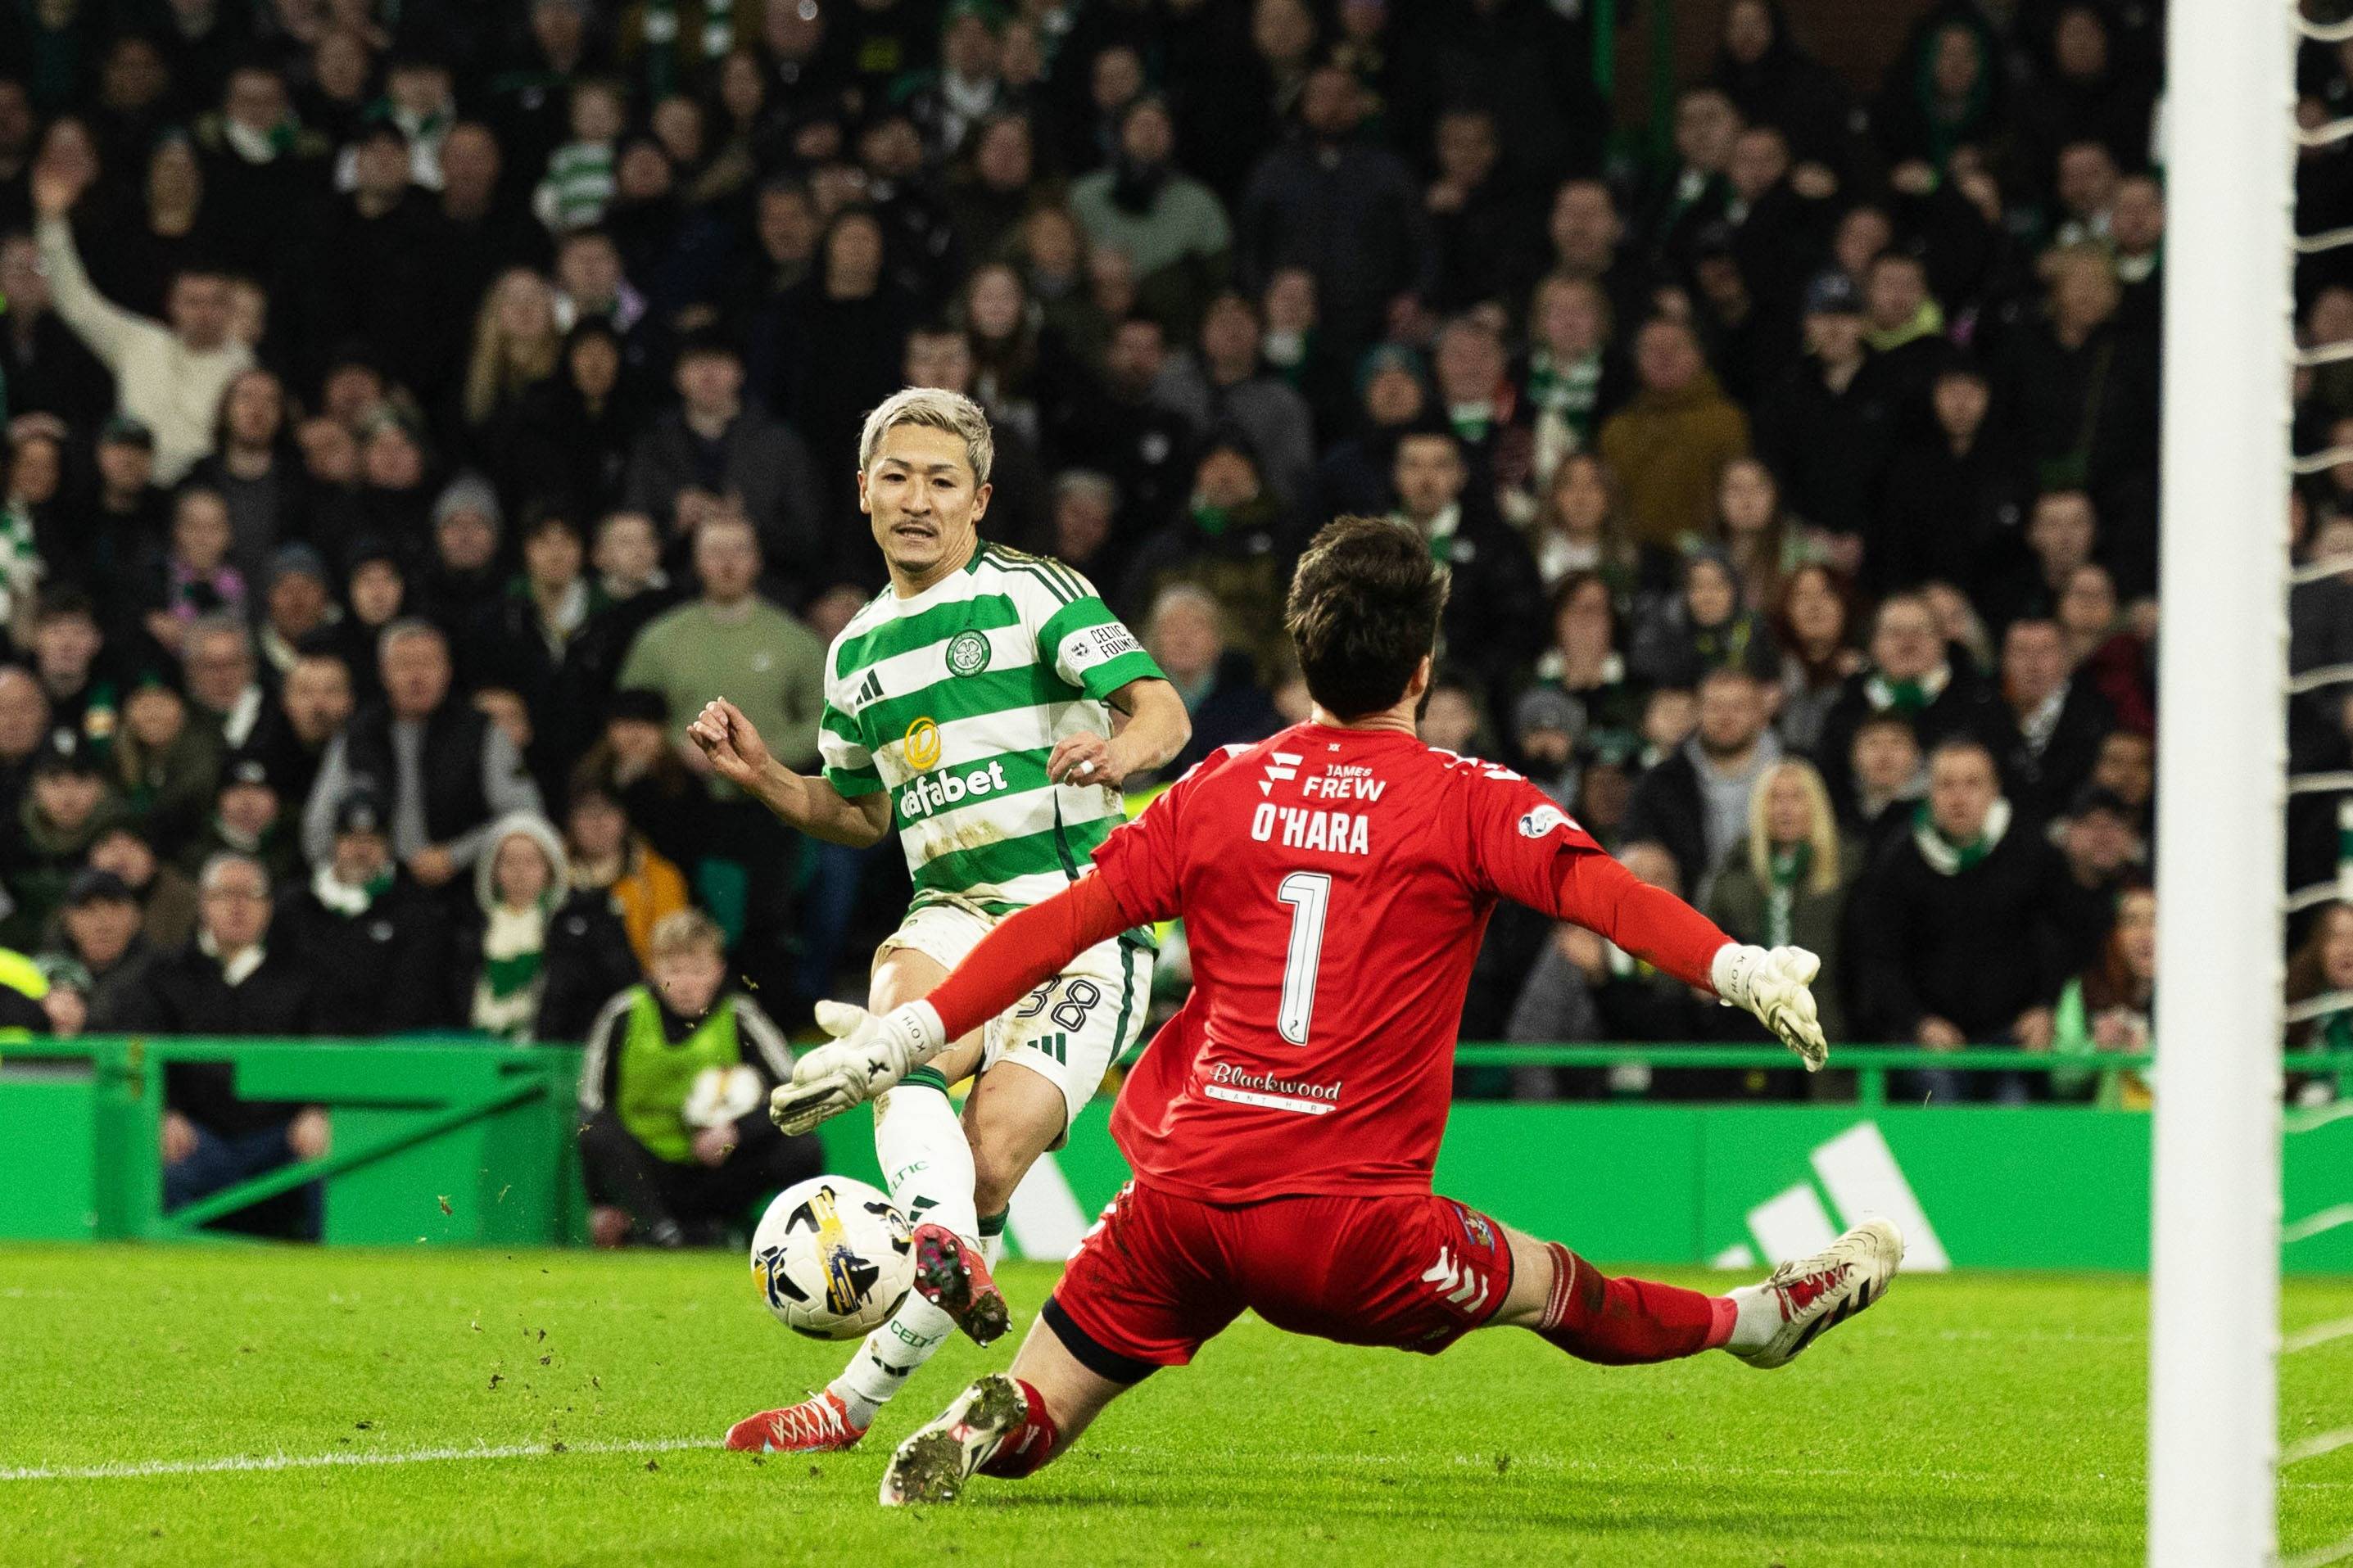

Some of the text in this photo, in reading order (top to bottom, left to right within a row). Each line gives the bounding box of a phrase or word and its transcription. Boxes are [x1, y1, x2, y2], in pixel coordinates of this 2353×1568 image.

[1090, 625, 1126, 644] CELTIC
[1100, 638, 1141, 658] FOUND
[1326, 764, 1373, 778] JAMES
[900, 760, 1008, 819] dafabet
[1302, 776, 1387, 802] FREW
[1251, 802, 1369, 856] O'HARA
[1279, 873, 1331, 1045] 1
[1016, 974, 1101, 1033] 38
[1207, 1087, 1268, 1105] PLANT
[1209, 1062, 1343, 1100] Blackwood
[889, 1160, 930, 1199] ELTIC
[890, 1320, 943, 1349] CELT
